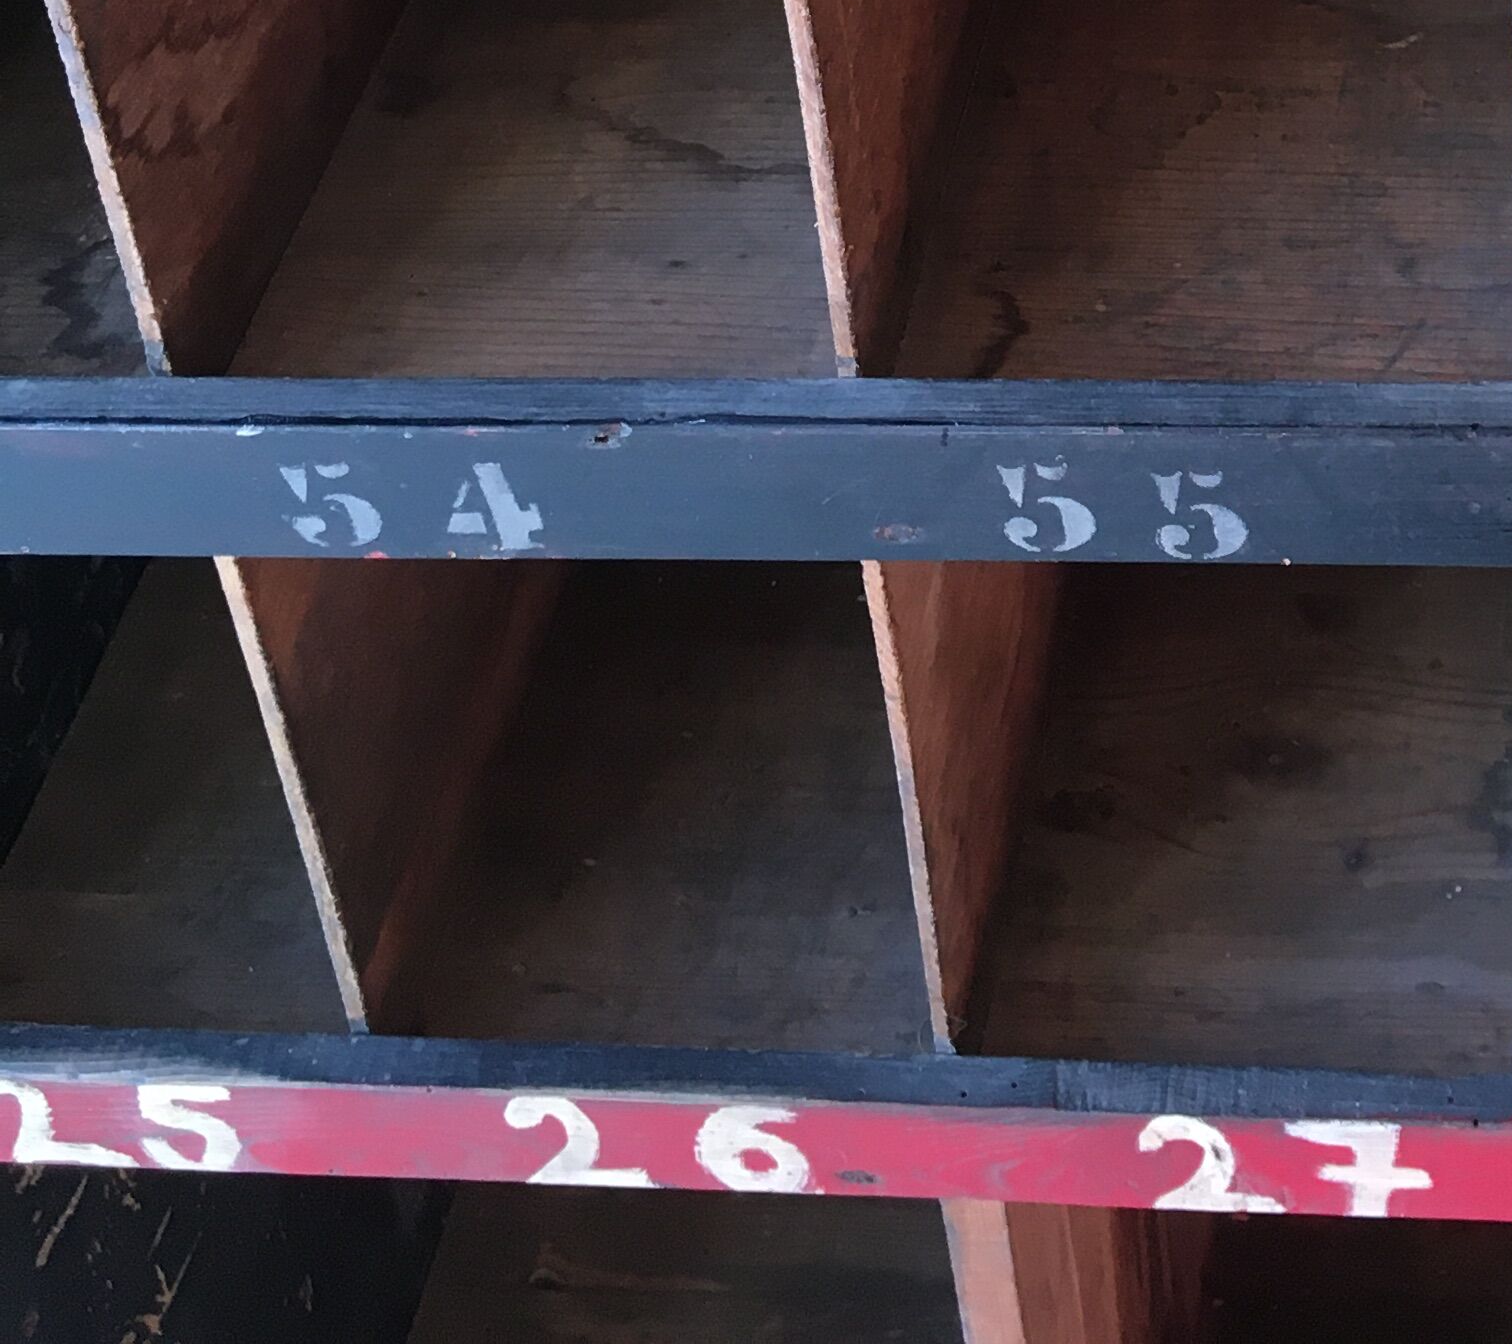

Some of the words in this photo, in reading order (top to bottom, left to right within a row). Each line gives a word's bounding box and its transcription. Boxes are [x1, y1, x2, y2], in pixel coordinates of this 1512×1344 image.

[279, 461, 545, 552] 54
[997, 454, 1248, 560] 55
[0, 1080, 242, 1172] 25
[503, 1095, 822, 1195] 26
[1138, 1112, 1432, 1218] 27
